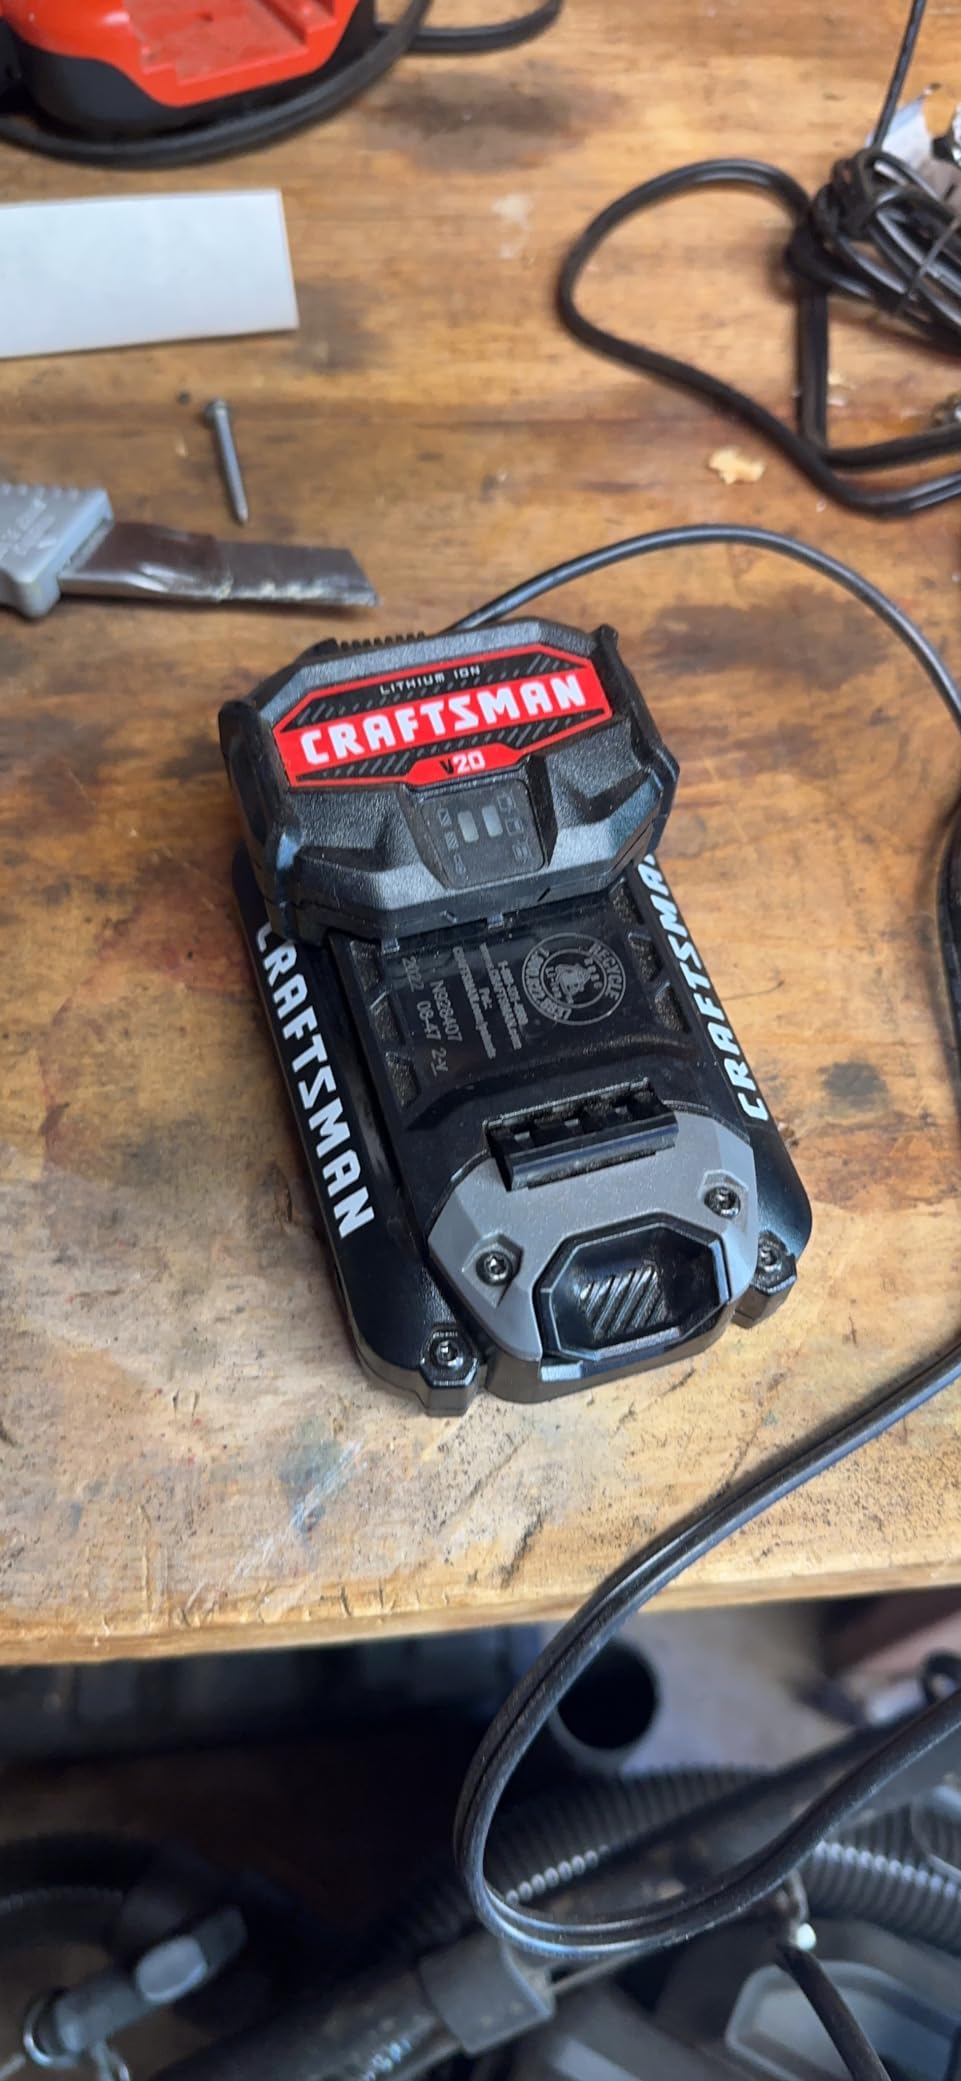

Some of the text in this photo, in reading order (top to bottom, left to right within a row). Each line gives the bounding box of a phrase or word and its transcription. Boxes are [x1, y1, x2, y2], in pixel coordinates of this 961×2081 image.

[379, 664, 482, 696] LITHIUM ION
[300, 674, 587, 765] CRAFTSMAN
[440, 750, 486, 775] V20
[402, 955, 425, 992] 2022
[587, 943, 622, 1000] RECYCLE
[637, 853, 769, 1121] CRAFTSMA
[430, 979, 464, 1042] N928407
